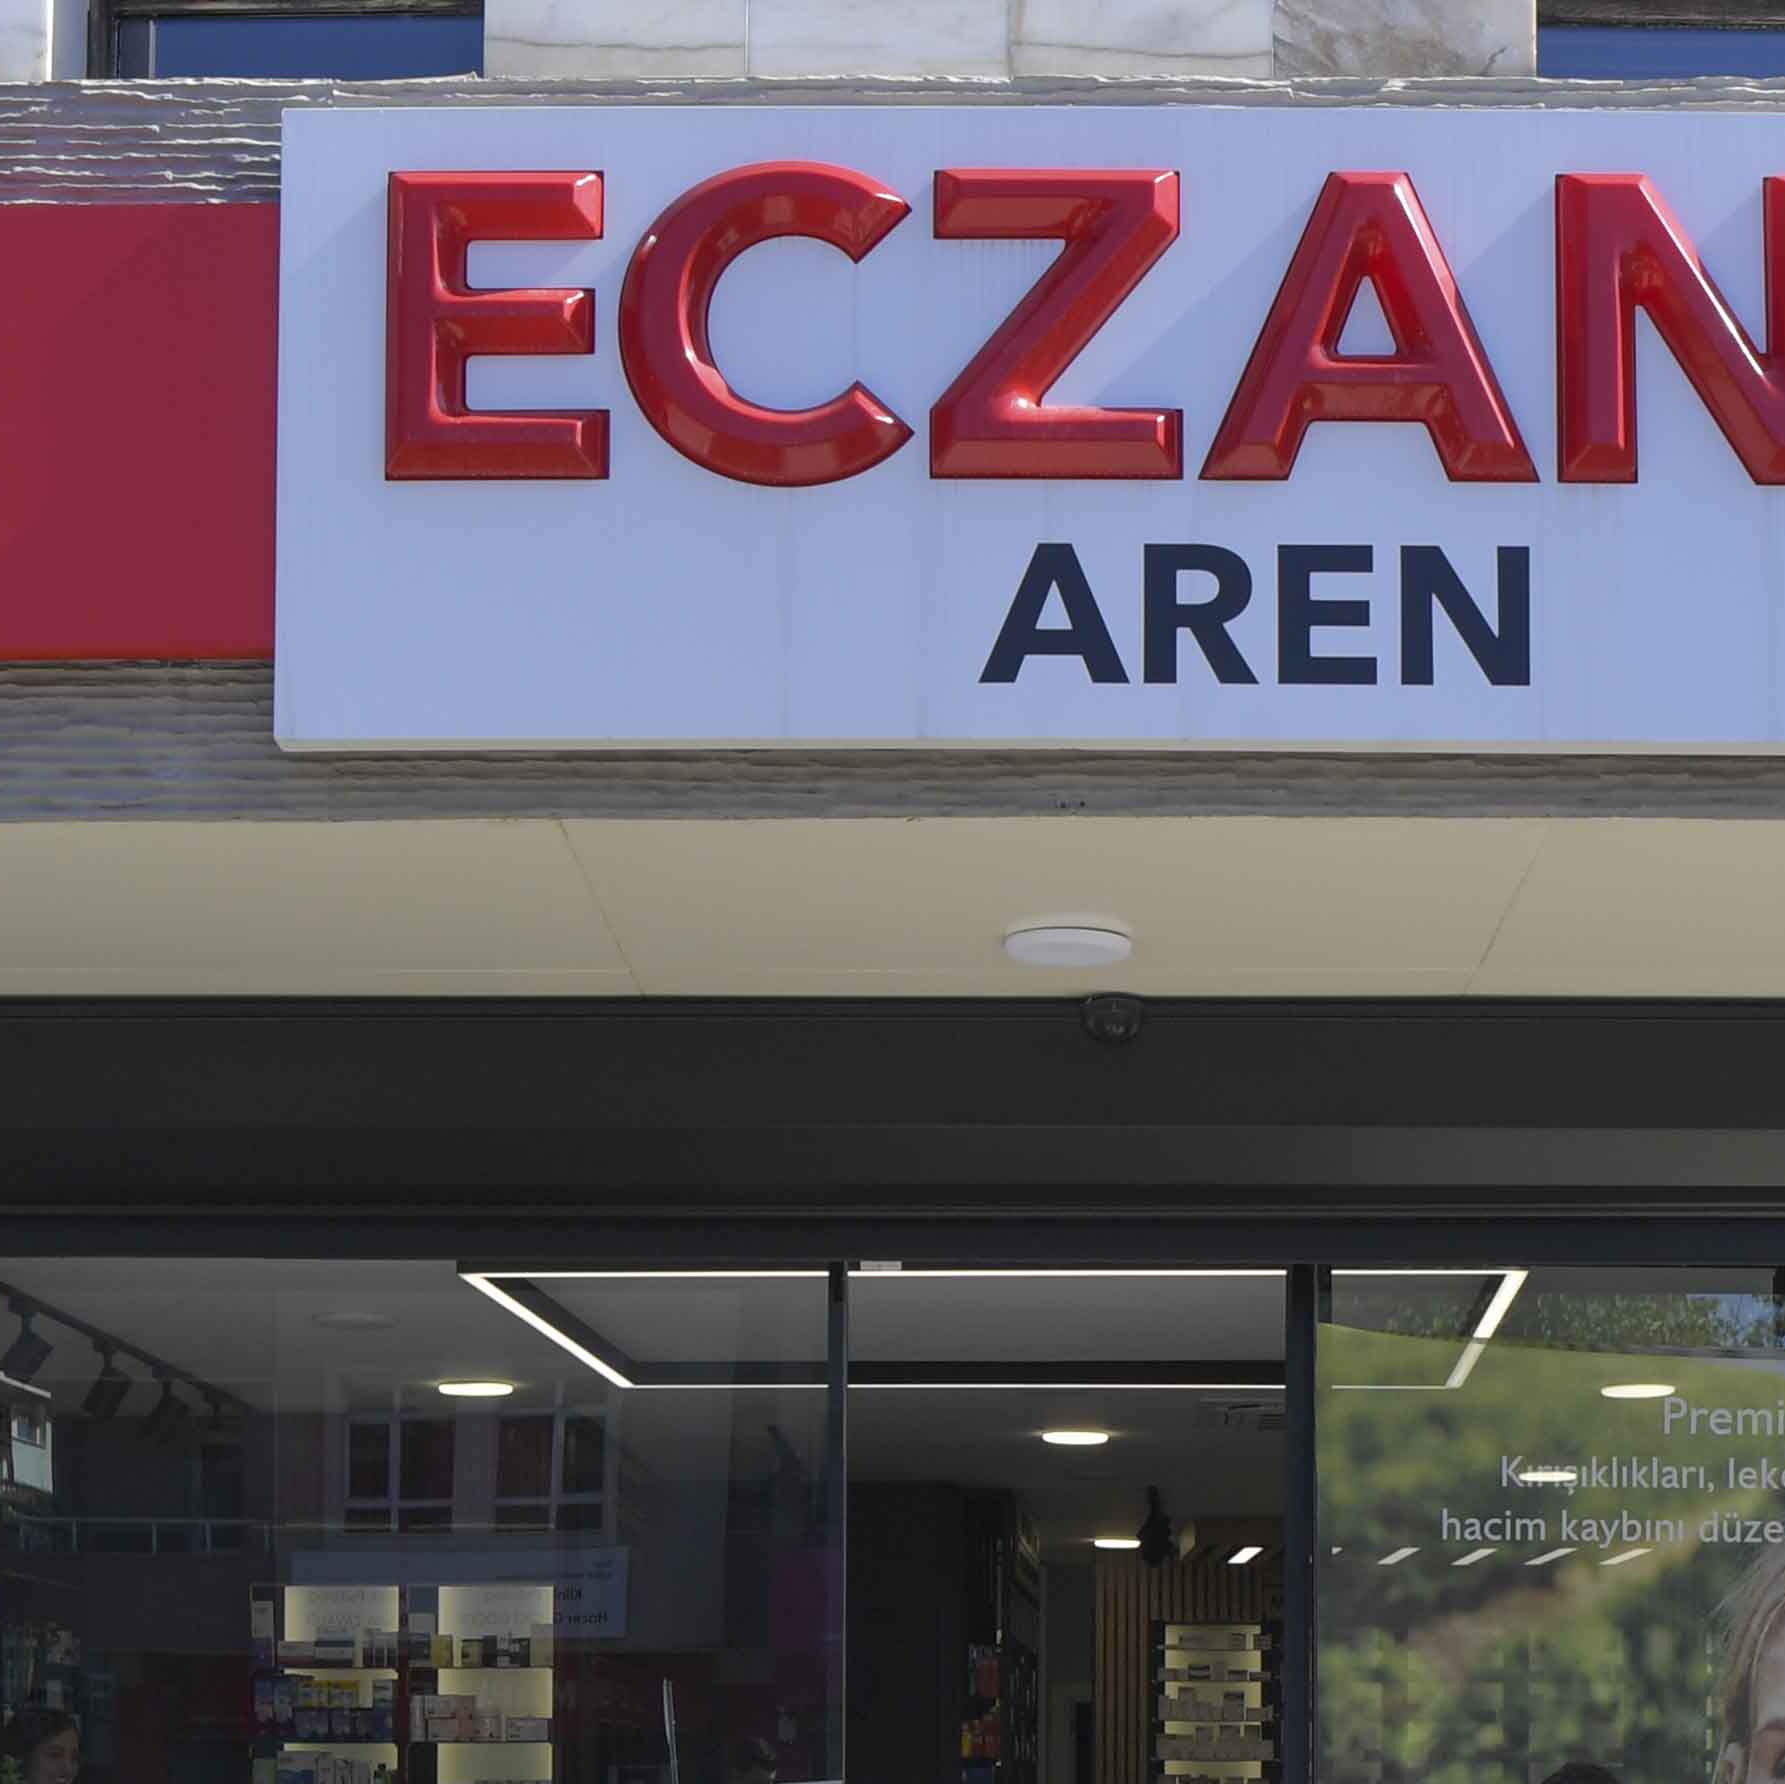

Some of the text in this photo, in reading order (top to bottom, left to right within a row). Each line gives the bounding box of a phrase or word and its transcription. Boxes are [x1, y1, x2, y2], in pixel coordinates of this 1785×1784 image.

[979, 543, 1533, 689] AREN
[1441, 1508, 1547, 1541] hacim
[1561, 1510, 1686, 1549] kaybını
